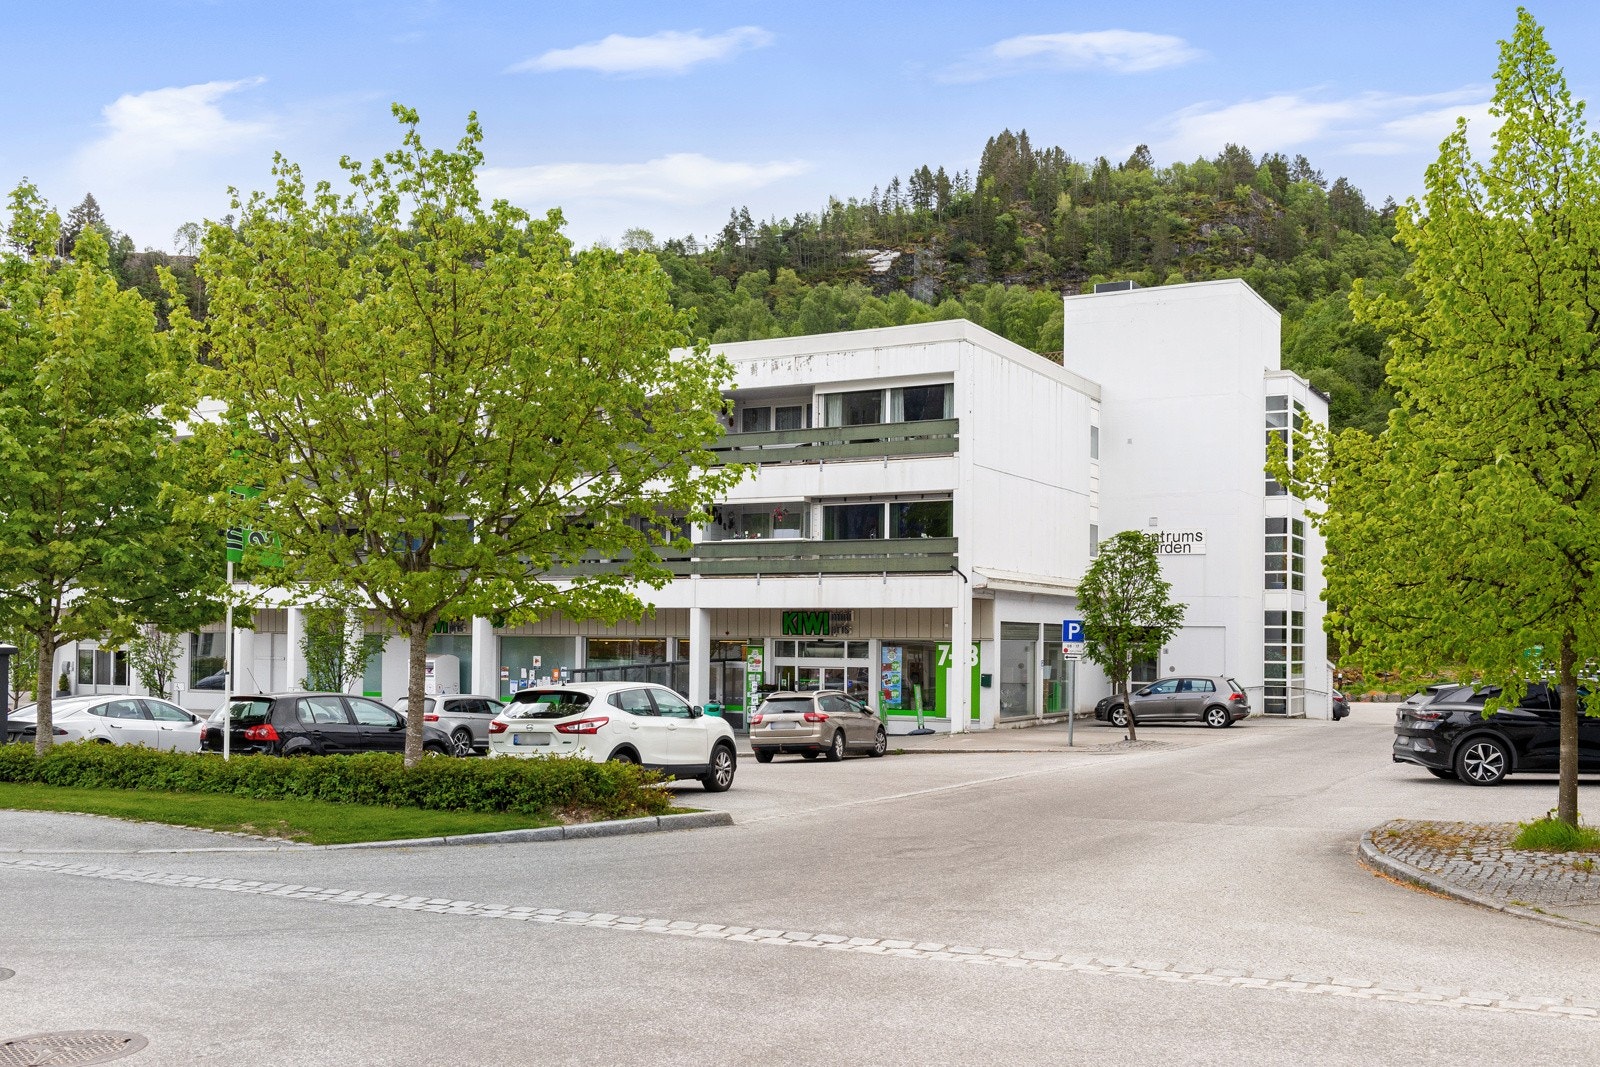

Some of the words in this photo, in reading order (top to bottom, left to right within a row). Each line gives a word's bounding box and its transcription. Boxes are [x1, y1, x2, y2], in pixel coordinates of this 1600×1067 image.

[1138, 529, 1203, 543] entrums
[782, 611, 830, 636] KIWI
[1068, 622, 1081, 640] P
